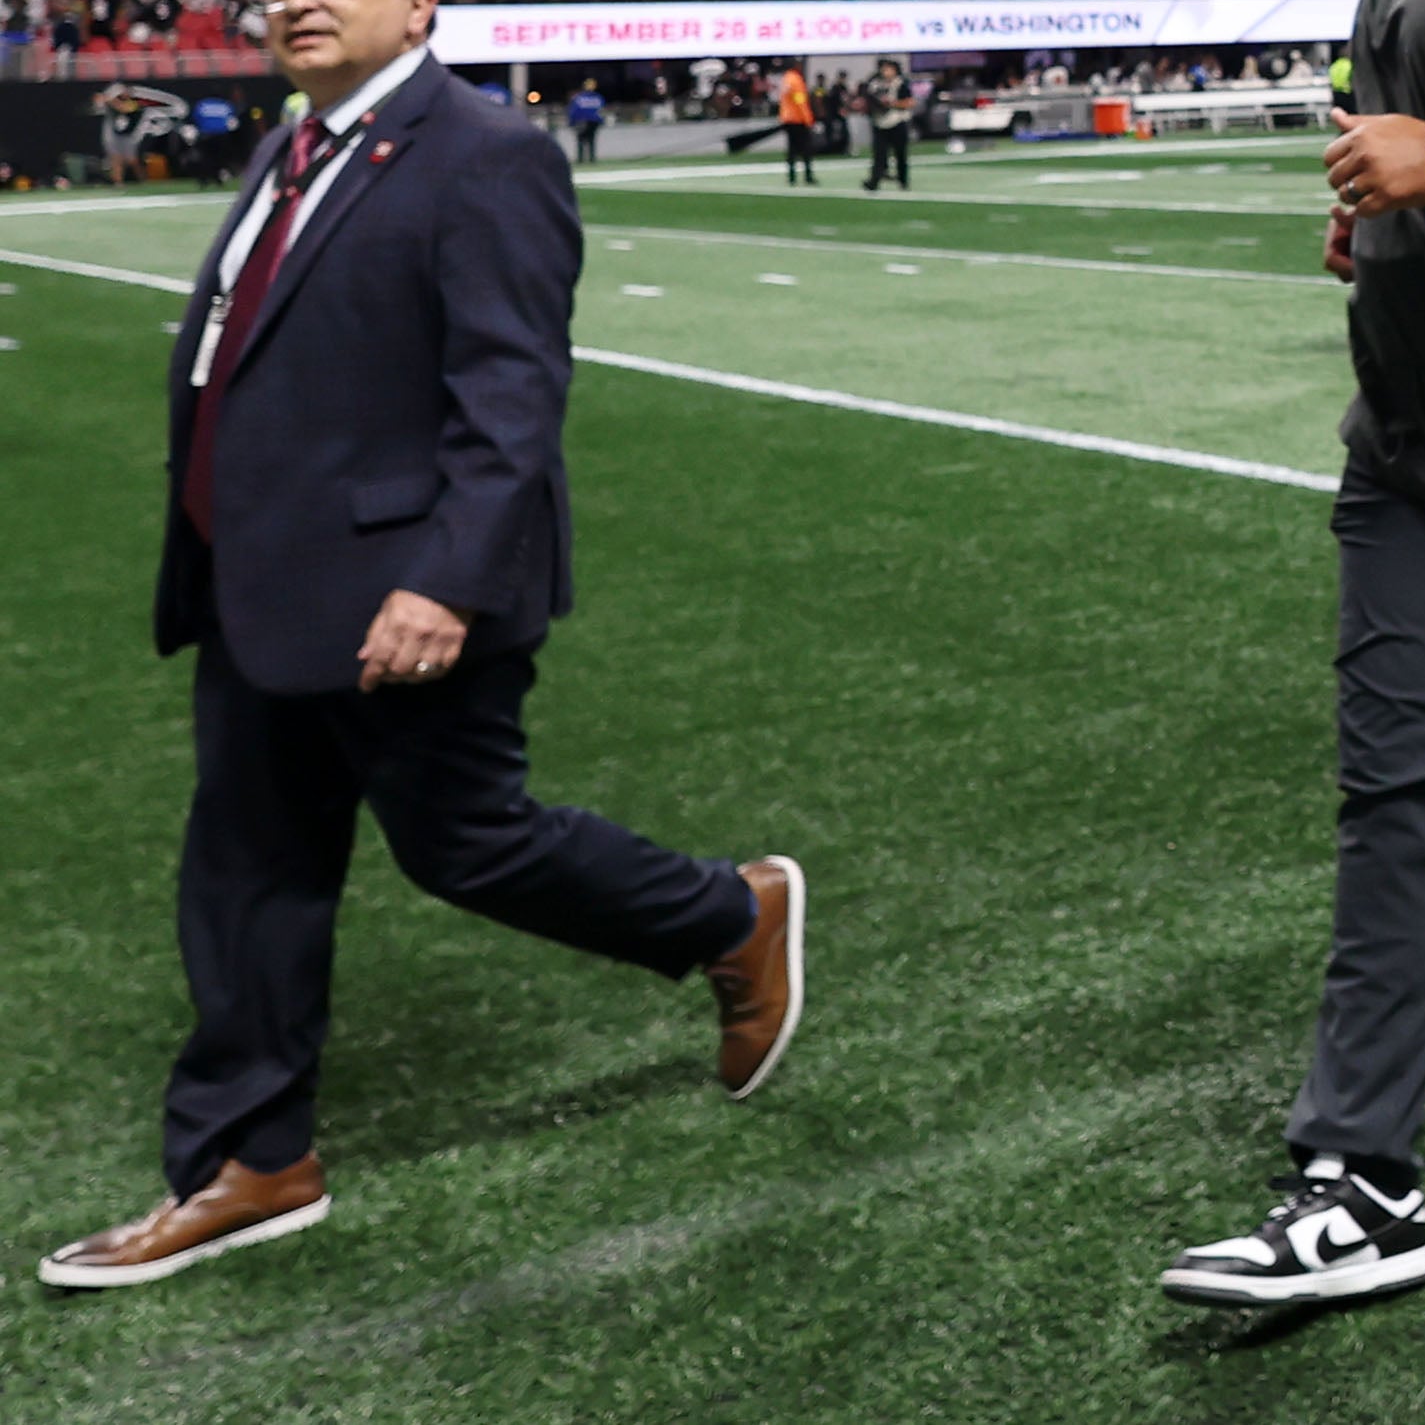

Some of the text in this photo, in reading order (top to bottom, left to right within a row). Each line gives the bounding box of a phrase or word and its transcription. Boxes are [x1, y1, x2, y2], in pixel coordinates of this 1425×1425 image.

[491, 12, 1143, 48] SEPTEMBER 28 at 1:00 pm vs WASHINGTON
